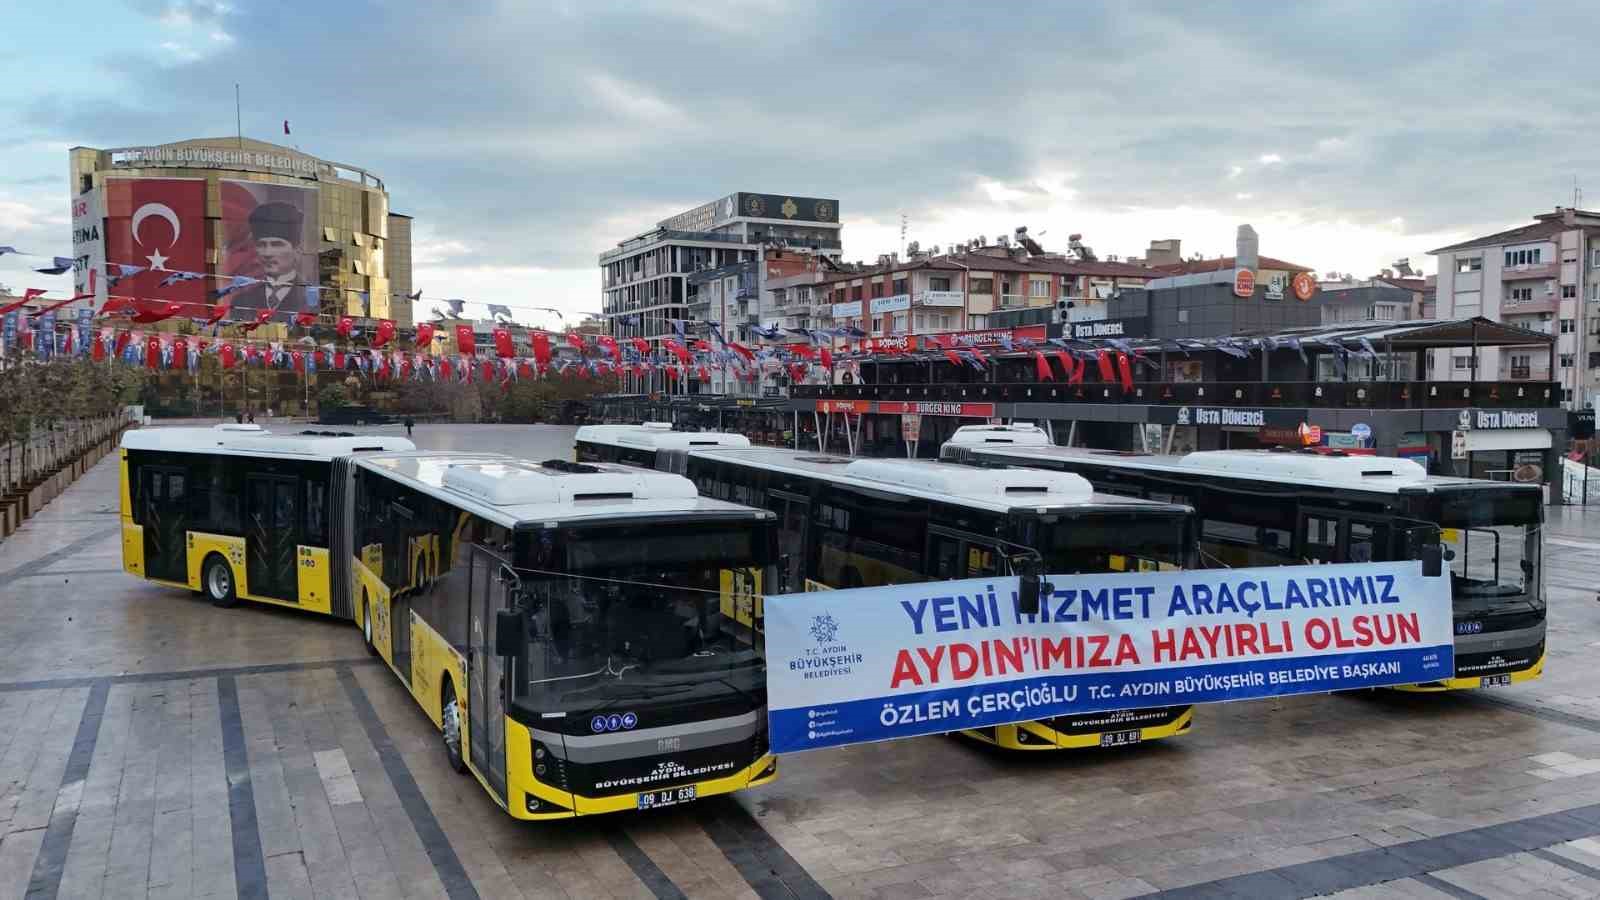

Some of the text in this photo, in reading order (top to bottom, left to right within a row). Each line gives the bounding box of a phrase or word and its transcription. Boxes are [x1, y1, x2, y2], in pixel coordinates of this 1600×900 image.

[143, 147, 174, 161] AYDIN
[916, 402, 961, 415] BURGER KING
[1196, 408, 1265, 426] USTA DÖNERCİ
[1477, 410, 1539, 428] USTA DÖNERCİ
[900, 584, 1001, 635] YENİ
[1167, 574, 1400, 617] ARAÇLARIMIZ
[1151, 620, 1294, 664] HAYIRLI
[1304, 612, 1422, 651] OLSUN
[822, 645, 847, 654] AYDIN
[790, 653, 863, 670] BÜYÜKŞEHİR
[804, 666, 851, 680] BELEDİYESİ
[880, 660, 1401, 727] ÖZLEM ÇERÇİOĞLU T.C. AYDIN BÜYÜKŞEHİR BELEDİYE BAŞKANI
[595, 761, 734, 789] BÜYÜKŞEHİR BELEDİYESİ
[650, 765, 685, 776] AYDIN
[643, 794, 655, 805] 09
[661, 791, 673, 802] DJ
